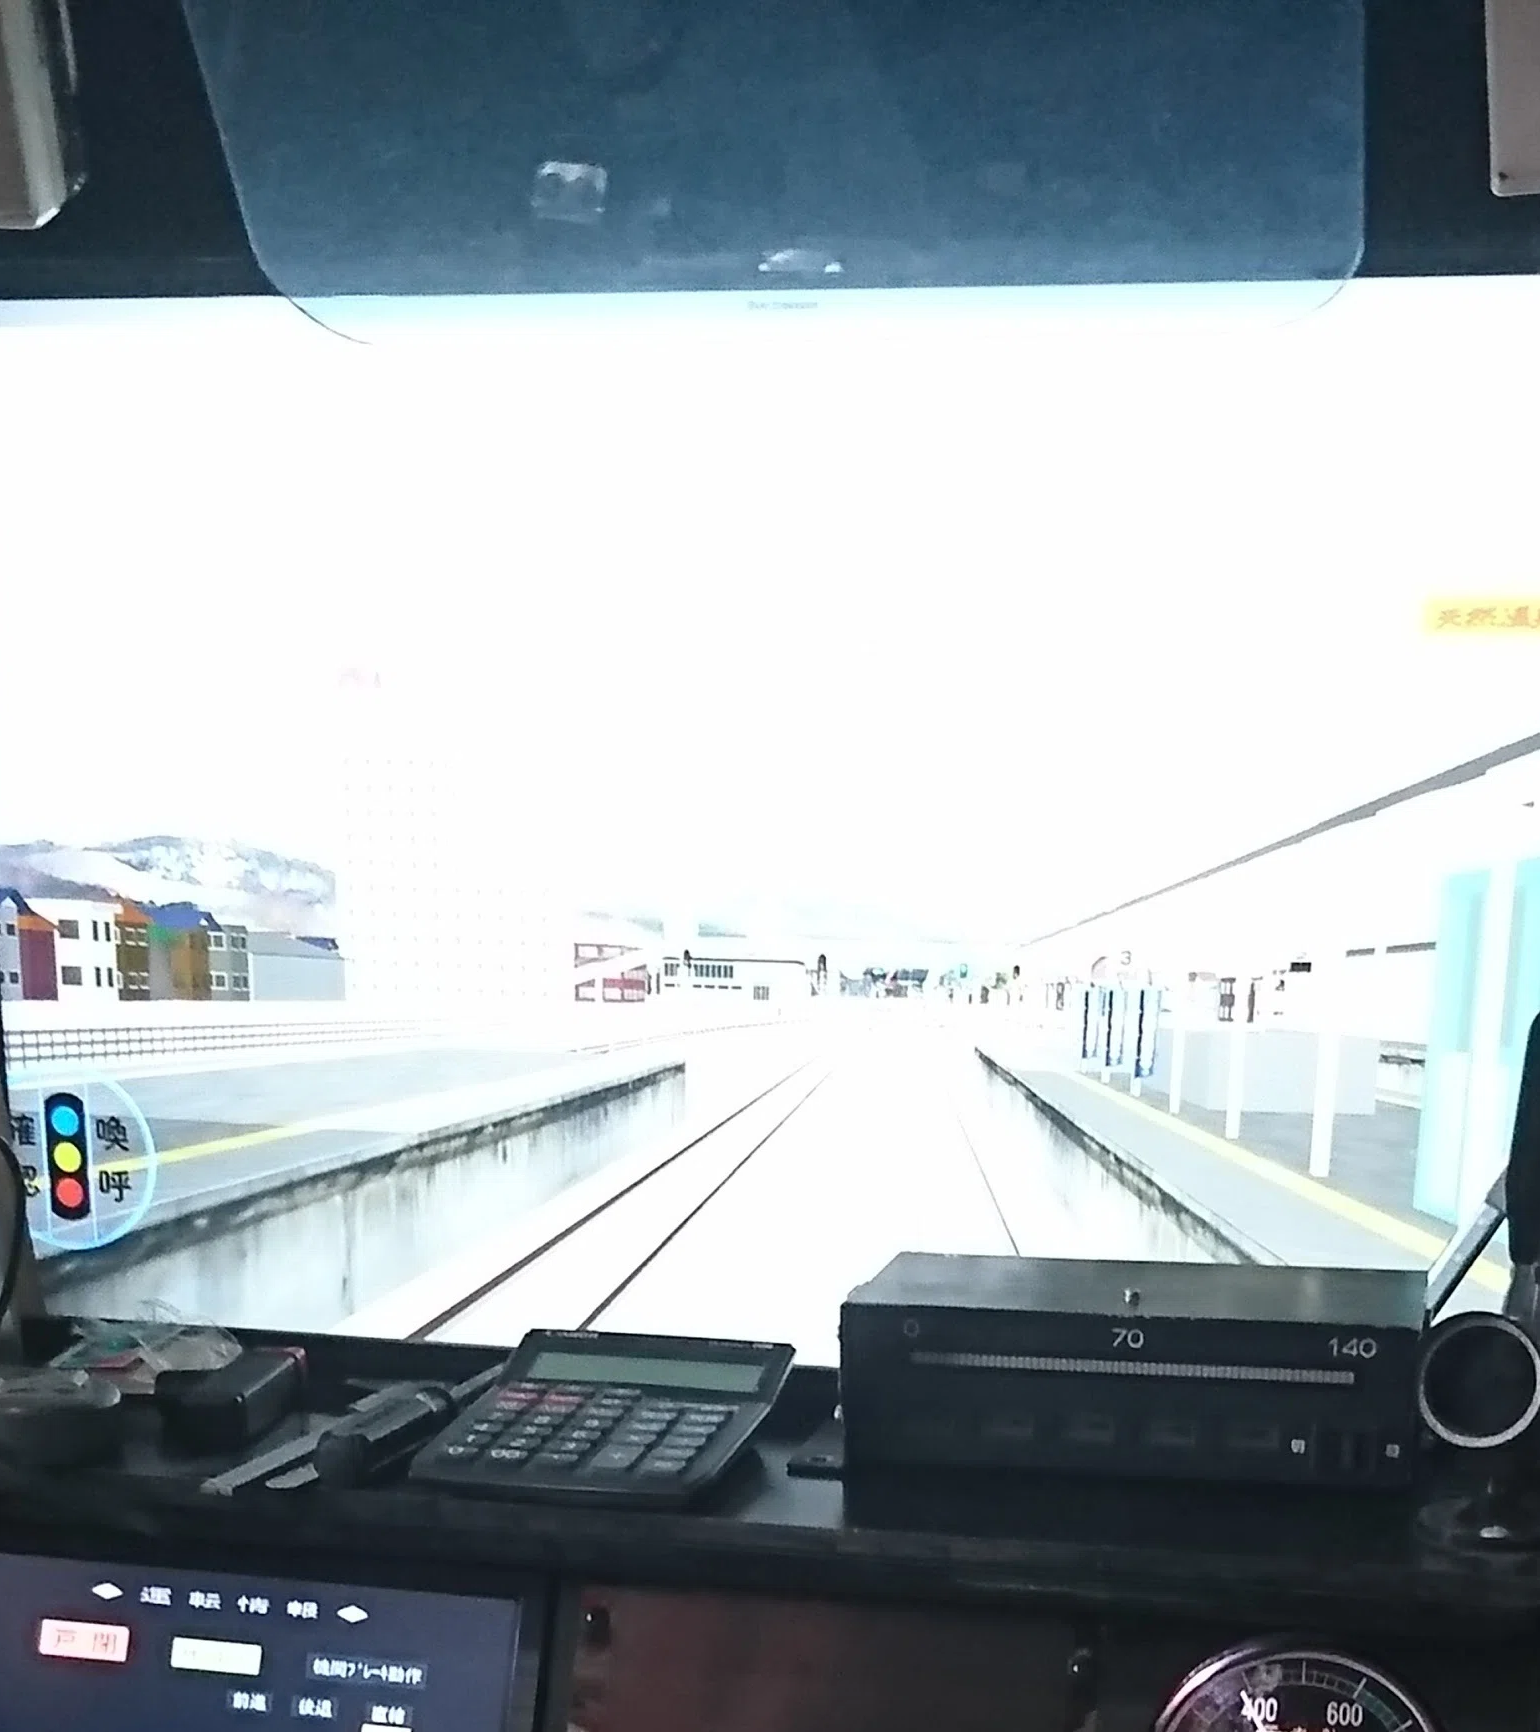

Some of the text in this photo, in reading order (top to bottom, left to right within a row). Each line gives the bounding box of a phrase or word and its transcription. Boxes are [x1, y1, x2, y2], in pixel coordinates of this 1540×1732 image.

[96, 1115, 132, 1204] 喚呼
[1110, 1327, 1145, 1349] 70
[1327, 1337, 1378, 1360] 140
[1326, 1701, 1363, 1726] 600
